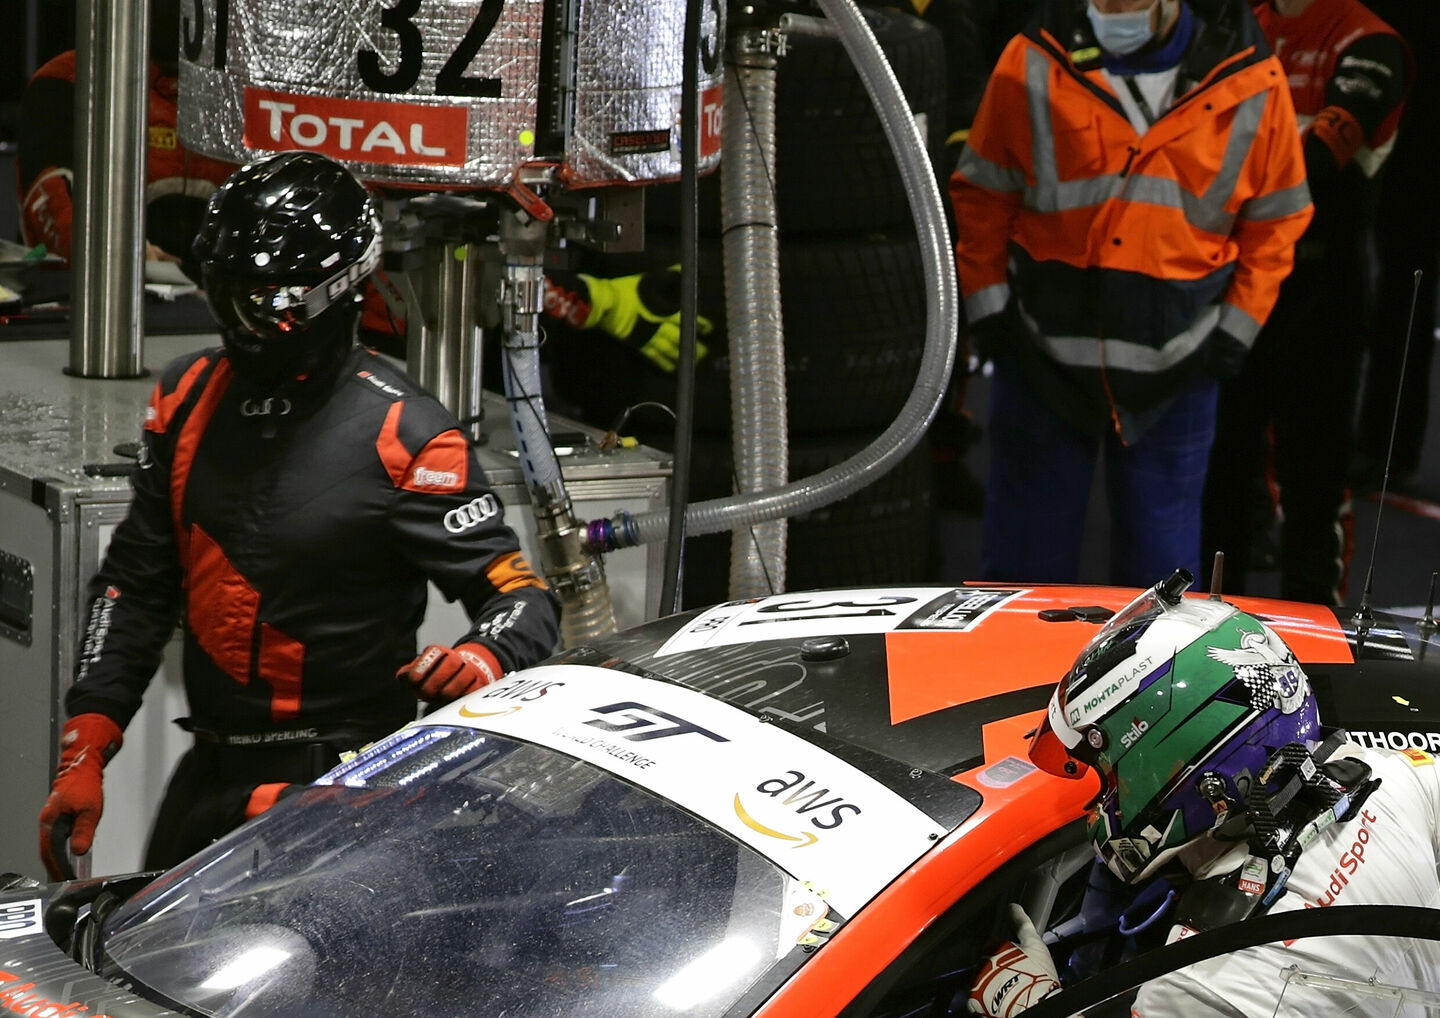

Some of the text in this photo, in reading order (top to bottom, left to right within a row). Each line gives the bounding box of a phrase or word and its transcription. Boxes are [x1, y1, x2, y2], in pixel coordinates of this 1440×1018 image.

[259, 100, 446, 156] TOTAL
[1083, 656, 1153, 714] MONTAPLAST
[581, 701, 732, 743] GT
[1121, 719, 1149, 749] Stilo
[588, 738, 656, 770] CHALLENGE
[1339, 808, 1378, 876] Sport
[1240, 880, 1261, 892] HANS
